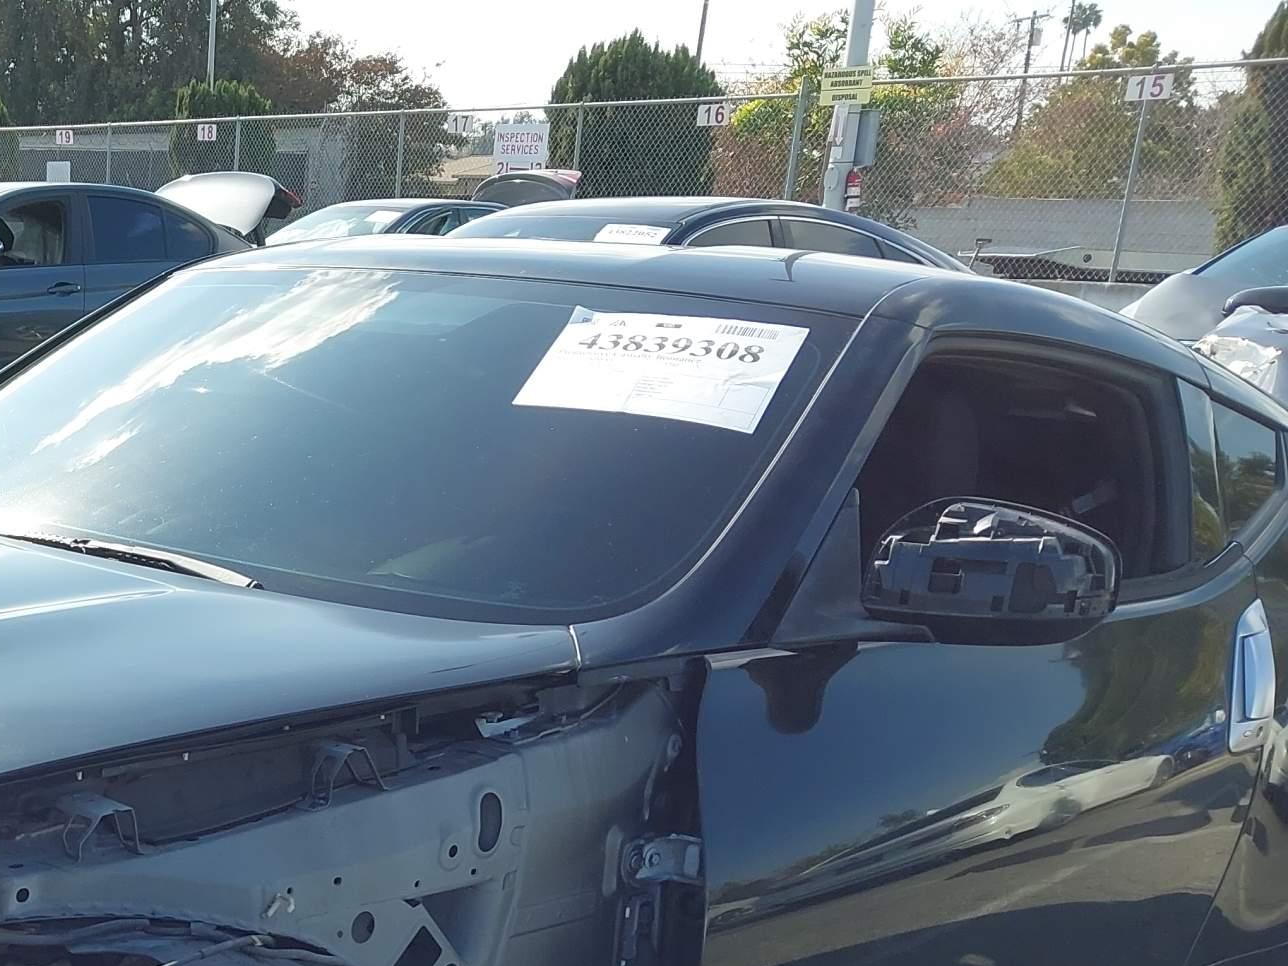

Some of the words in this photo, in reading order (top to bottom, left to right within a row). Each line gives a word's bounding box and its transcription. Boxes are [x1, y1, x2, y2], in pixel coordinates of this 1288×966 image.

[1135, 75, 1165, 99] 15
[705, 105, 724, 124] 16
[452, 117, 469, 132] 17
[58, 131, 71, 143] 19
[201, 125, 213, 140] 18
[497, 132, 544, 143] INSPECTION
[500, 145, 539, 155] SERVICES
[578, 332, 765, 364] 43839308
